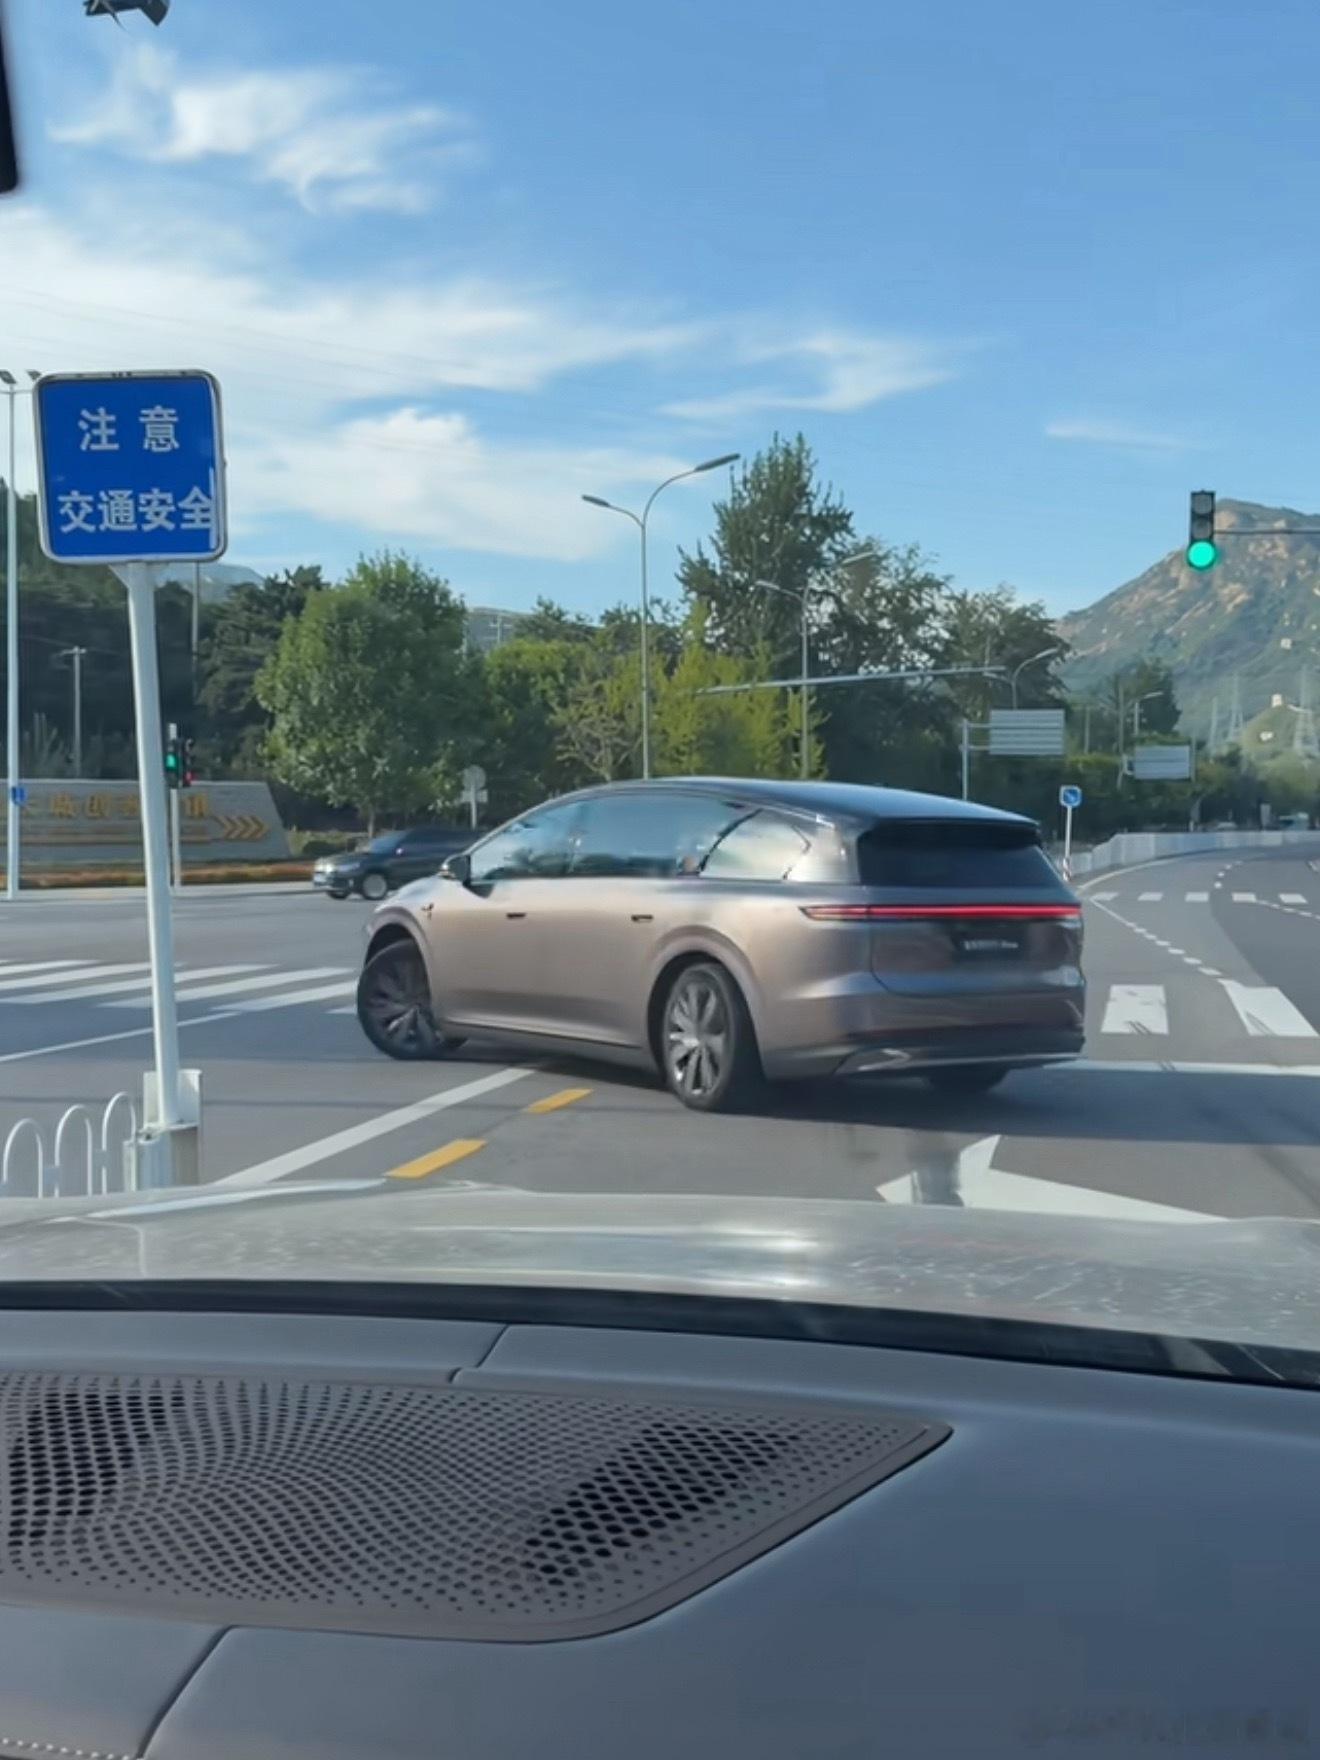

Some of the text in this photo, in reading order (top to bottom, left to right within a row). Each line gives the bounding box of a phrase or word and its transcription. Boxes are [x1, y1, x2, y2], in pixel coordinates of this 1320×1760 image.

[78, 405, 180, 452] 注意
[57, 486, 213, 533] 交通安全
